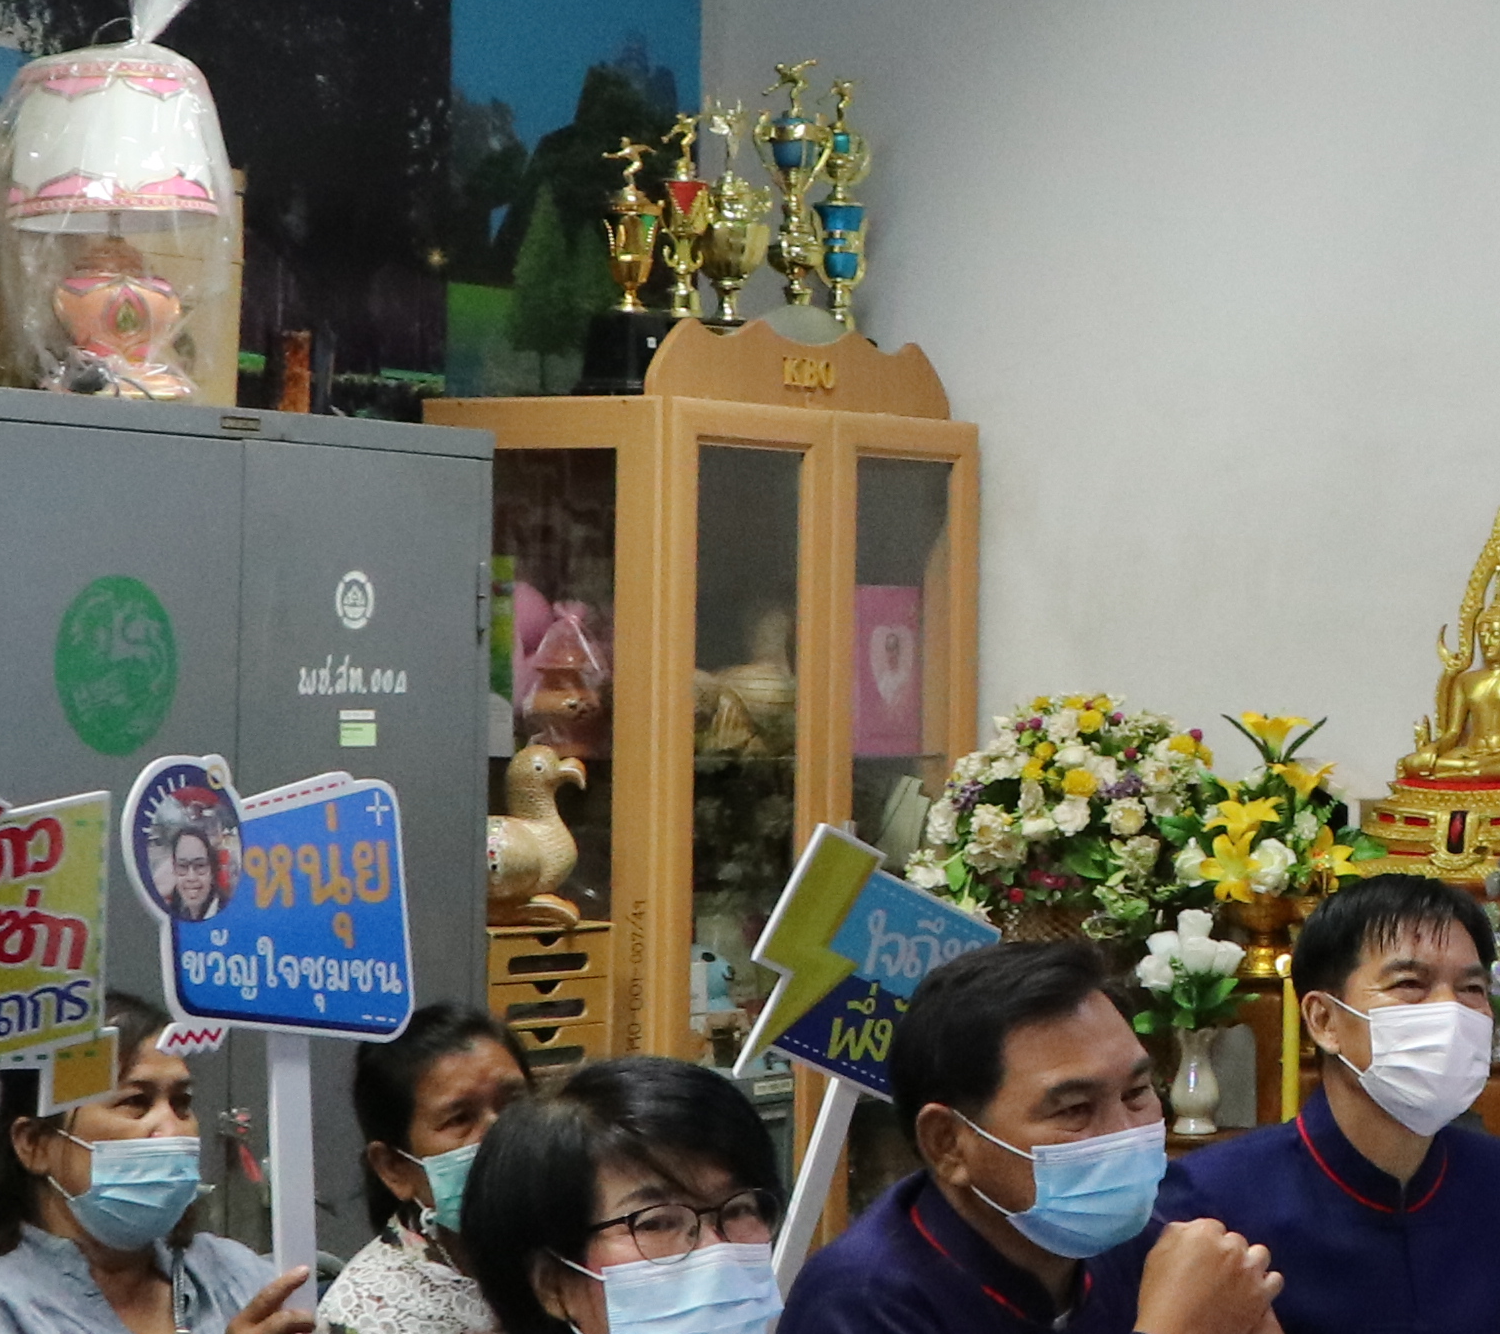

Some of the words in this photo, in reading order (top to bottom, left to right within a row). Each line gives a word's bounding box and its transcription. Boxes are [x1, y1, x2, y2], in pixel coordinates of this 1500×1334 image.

[783, 357, 836, 390] KBO
[242, 802, 390, 949] หนุ่ย
[181, 933, 404, 1014] ขวัญใจชุมชน
